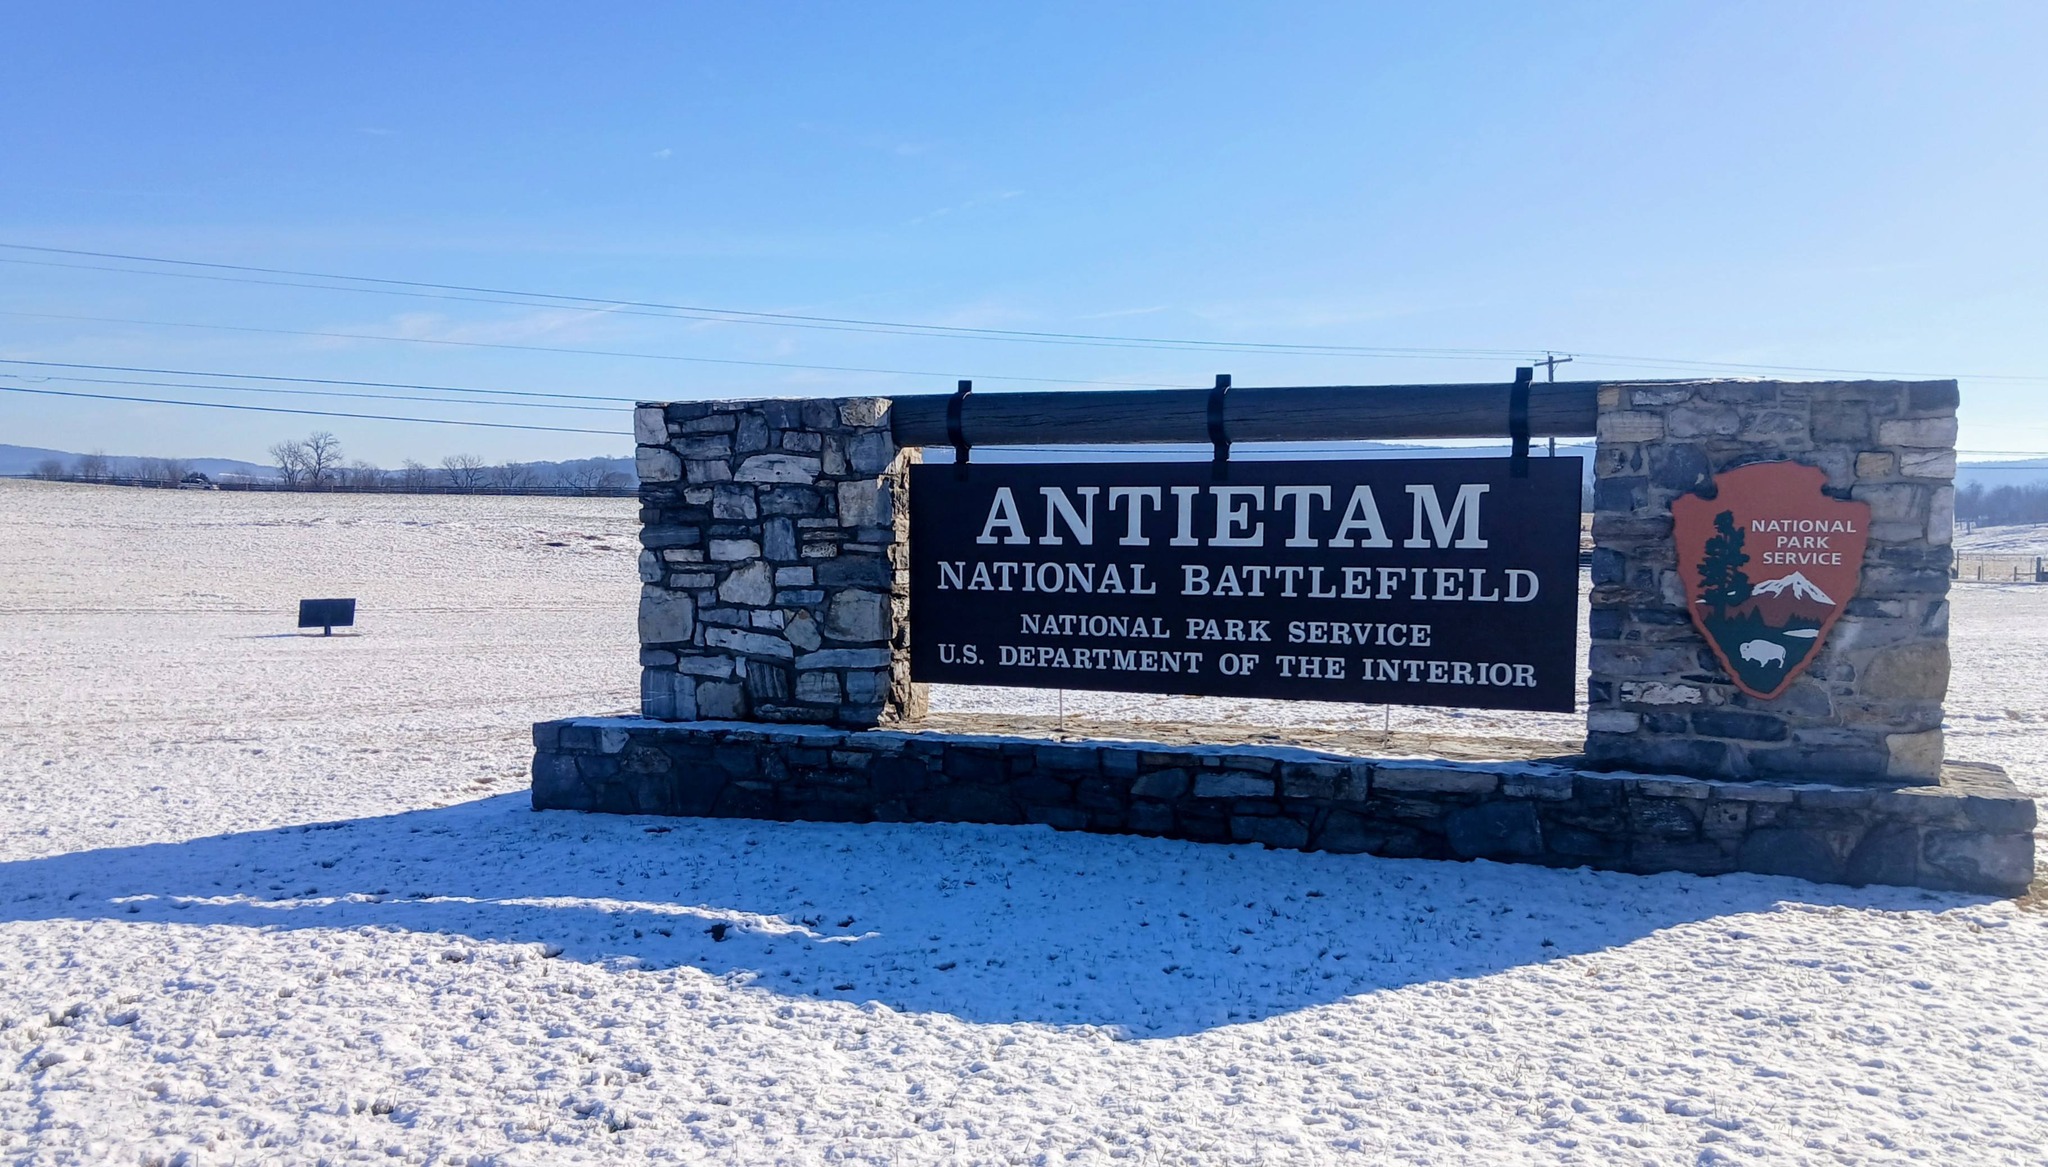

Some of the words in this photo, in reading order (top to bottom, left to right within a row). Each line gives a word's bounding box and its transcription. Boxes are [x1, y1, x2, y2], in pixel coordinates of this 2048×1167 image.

[977, 484, 1489, 548] ANTIETAM
[1751, 519, 1857, 533] NATIONAL
[1777, 536, 1830, 549] PARK
[1763, 552, 1842, 566] SERVICE
[938, 562, 1155, 594] NATIONAL
[1181, 565, 1538, 601] BATTLEFIELD
[1021, 615, 1169, 637] NATIONAL
[1186, 619, 1271, 641] PARK
[1289, 622, 1430, 646] SERVICE
[938, 644, 984, 664] U.S.
[999, 646, 1202, 673] DEPARTMENT
[1220, 654, 1259, 675] OF
[1276, 656, 1344, 678] THE
[1363, 659, 1536, 687] INTERIOR
